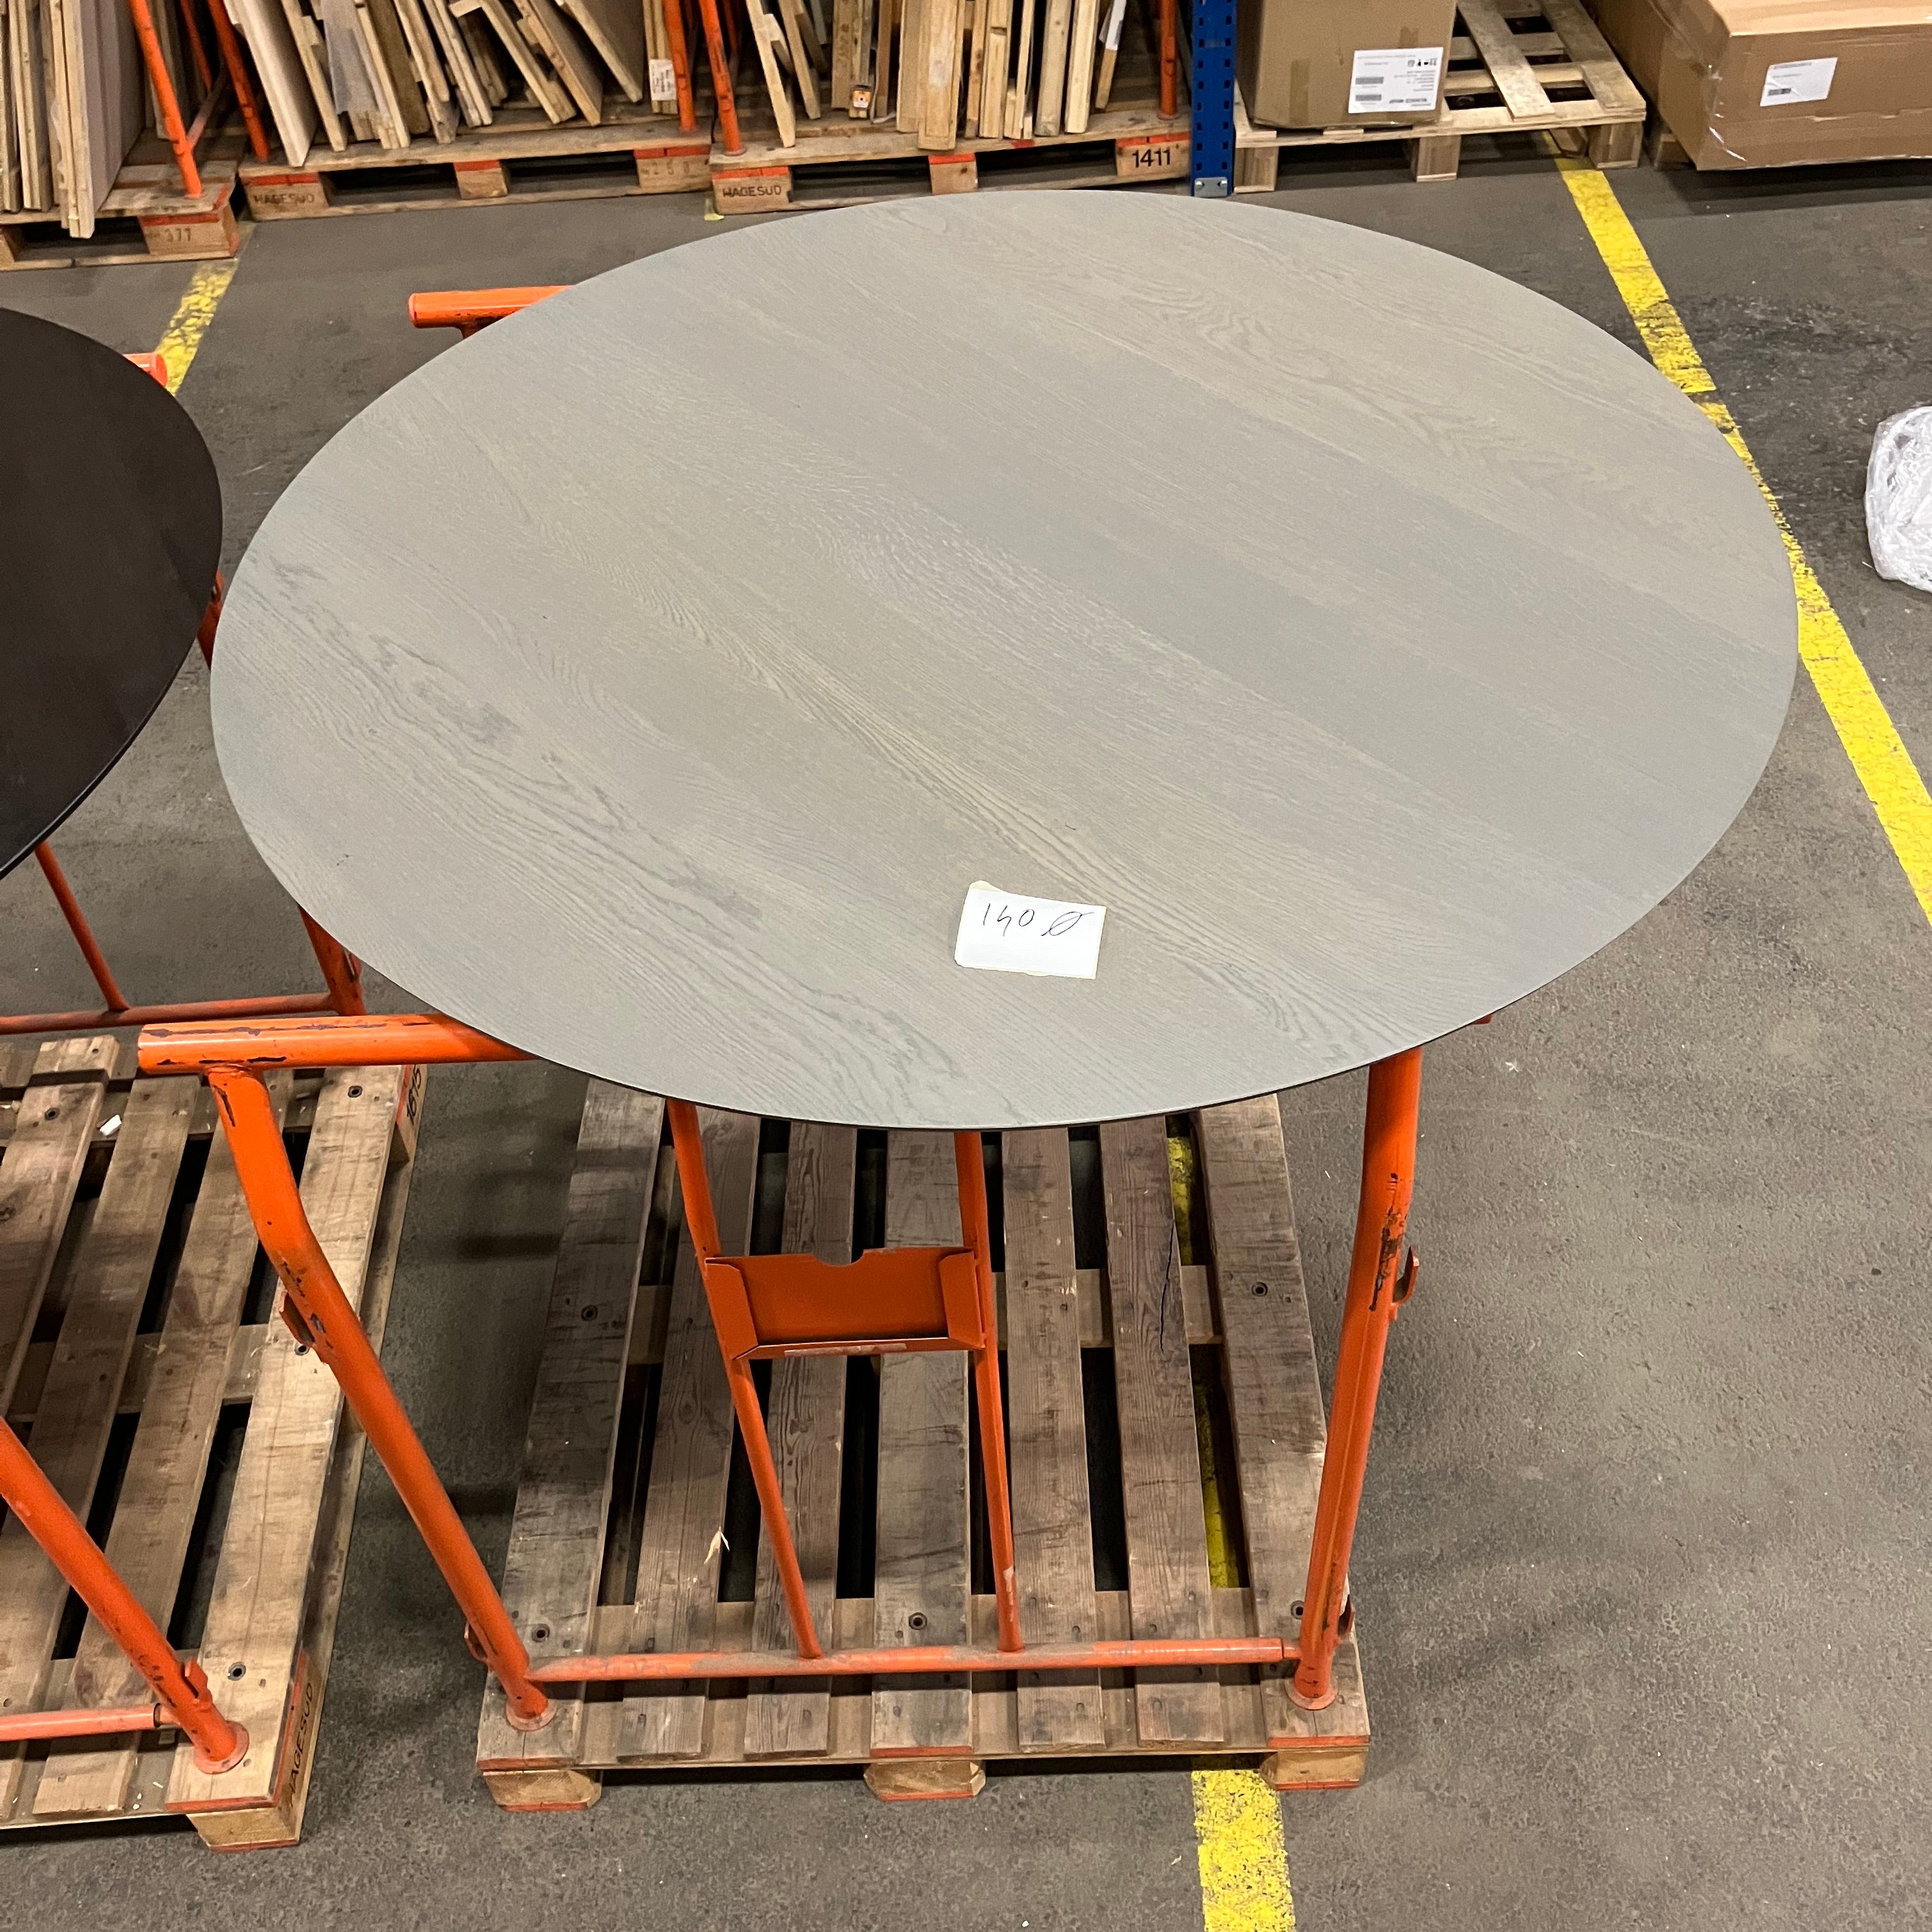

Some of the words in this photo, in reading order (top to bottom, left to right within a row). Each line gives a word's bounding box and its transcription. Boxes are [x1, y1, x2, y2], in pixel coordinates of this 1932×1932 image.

[1132, 148, 1170, 167] 1411
[722, 185, 781, 197] HAGESUD
[983, 903, 1034, 937] 140
[288, 1682, 312, 1807] HAGESUD
